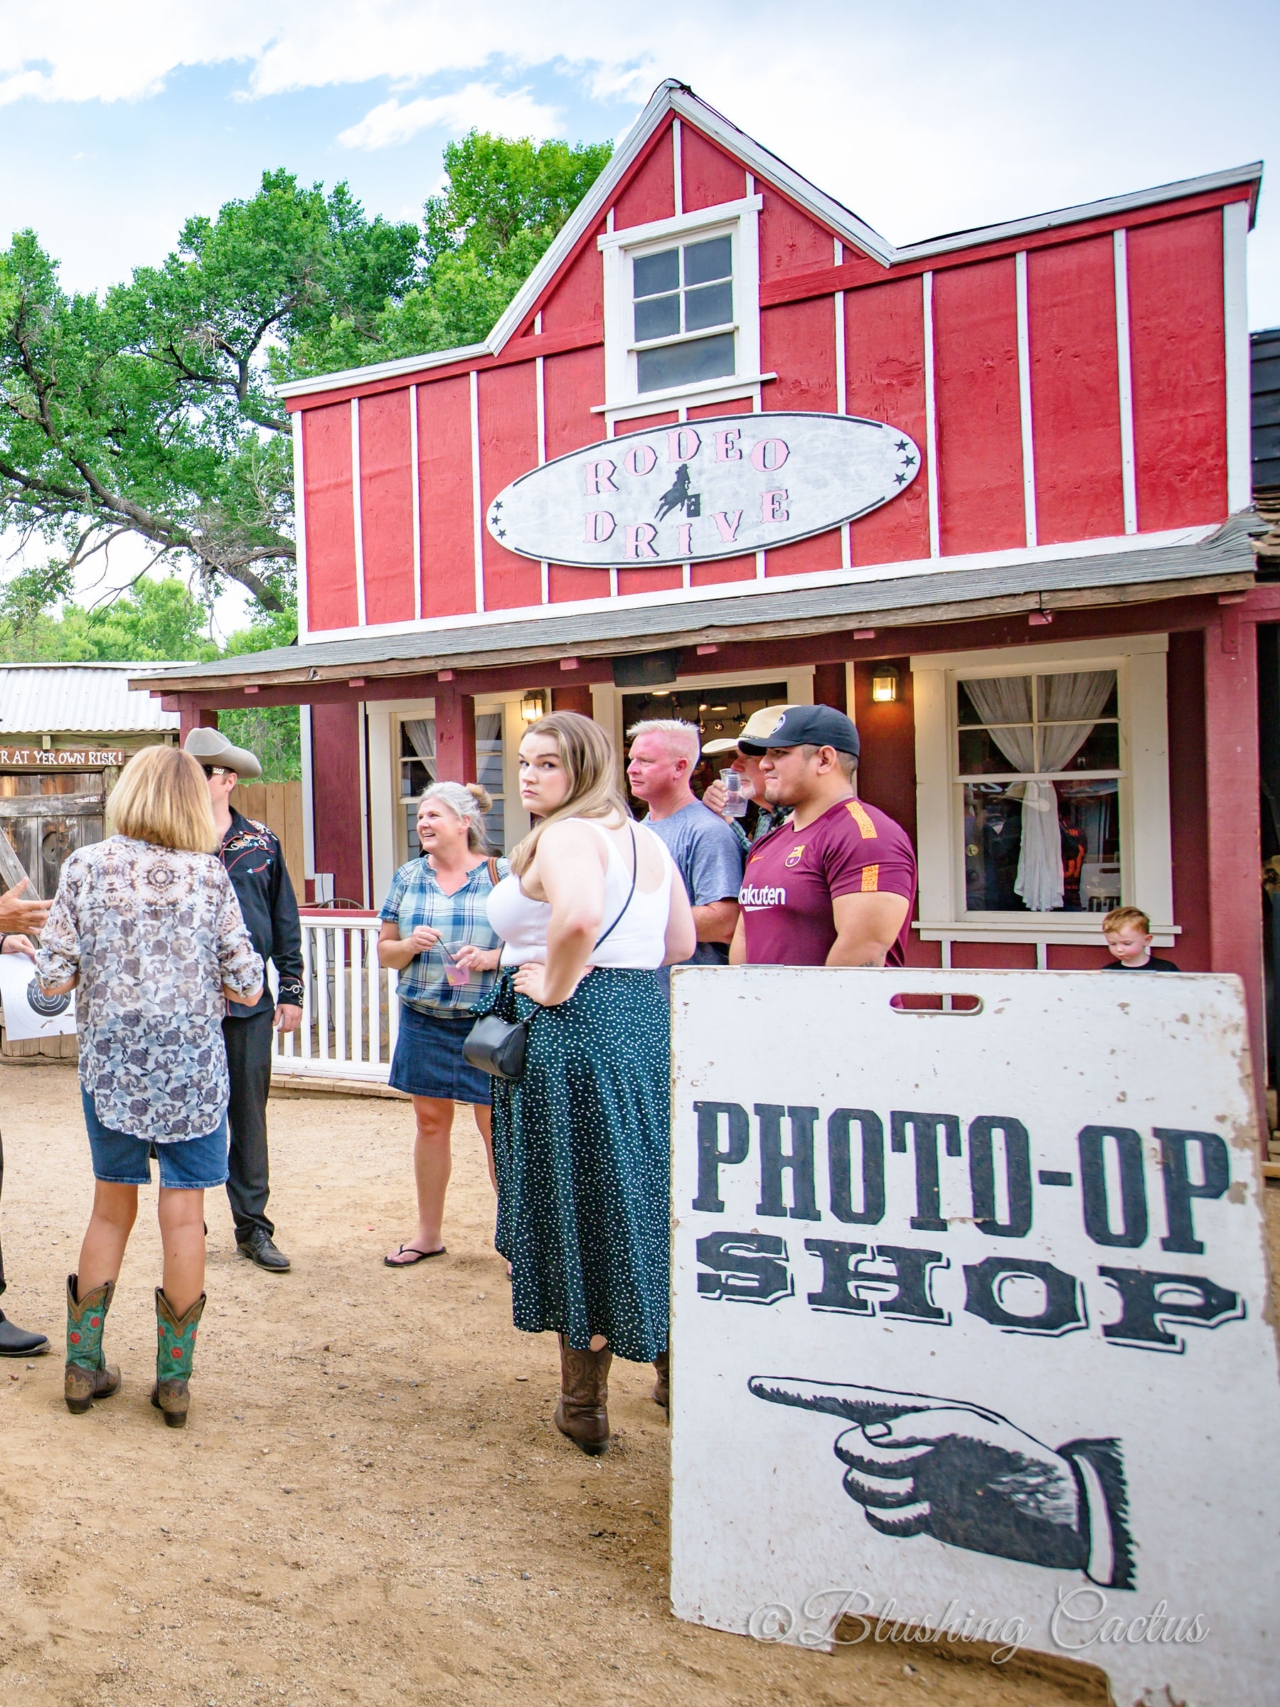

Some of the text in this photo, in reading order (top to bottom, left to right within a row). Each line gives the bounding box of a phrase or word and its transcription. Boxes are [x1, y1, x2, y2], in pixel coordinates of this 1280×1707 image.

[584, 428, 791, 496] RODEO
[584, 489, 790, 559] DRIVE
[12, 751, 30, 764] AT
[33, 751, 57, 765] YER
[58, 752, 85, 764] OWN
[88, 751, 123, 765] RISK!
[691, 1100, 1230, 1254] PHOTO-OP
[696, 1231, 1246, 1354] SHOP
